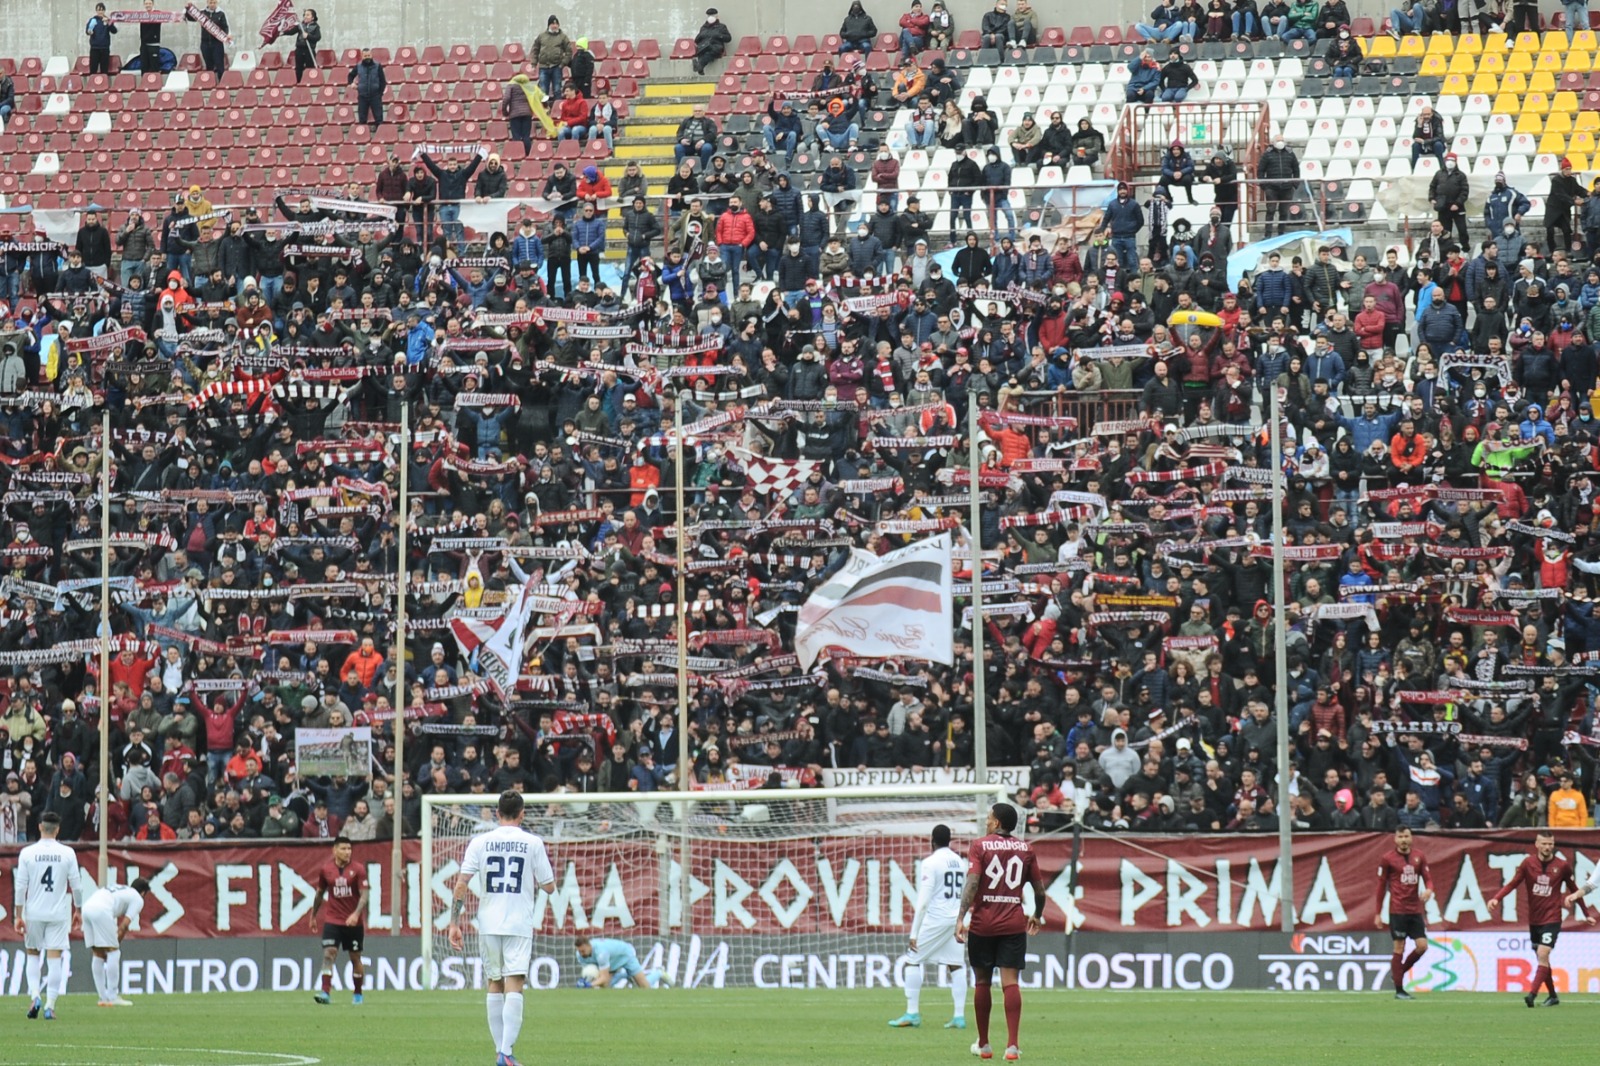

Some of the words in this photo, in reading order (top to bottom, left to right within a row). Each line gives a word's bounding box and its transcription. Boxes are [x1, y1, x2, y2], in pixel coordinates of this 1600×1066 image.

[872, 436, 914, 448] CURVA
[929, 435, 953, 447] SUD
[1438, 490, 1468, 500] REGGINA
[1468, 490, 1484, 500] 1914
[771, 656, 797, 668] SUD
[834, 769, 937, 787] DIFFIDATI
[952, 768, 1022, 786] LIERI
[484, 840, 528, 855] CAMPORESE
[41, 866, 54, 893] 4
[486, 856, 525, 894] 23
[985, 854, 1025, 890] 90
[943, 871, 965, 901] 95
[1119, 856, 1348, 928] PRIMA
[352, 940, 359, 951] 2
[1300, 935, 1370, 954] NGM
[120, 957, 258, 992] ENTRO
